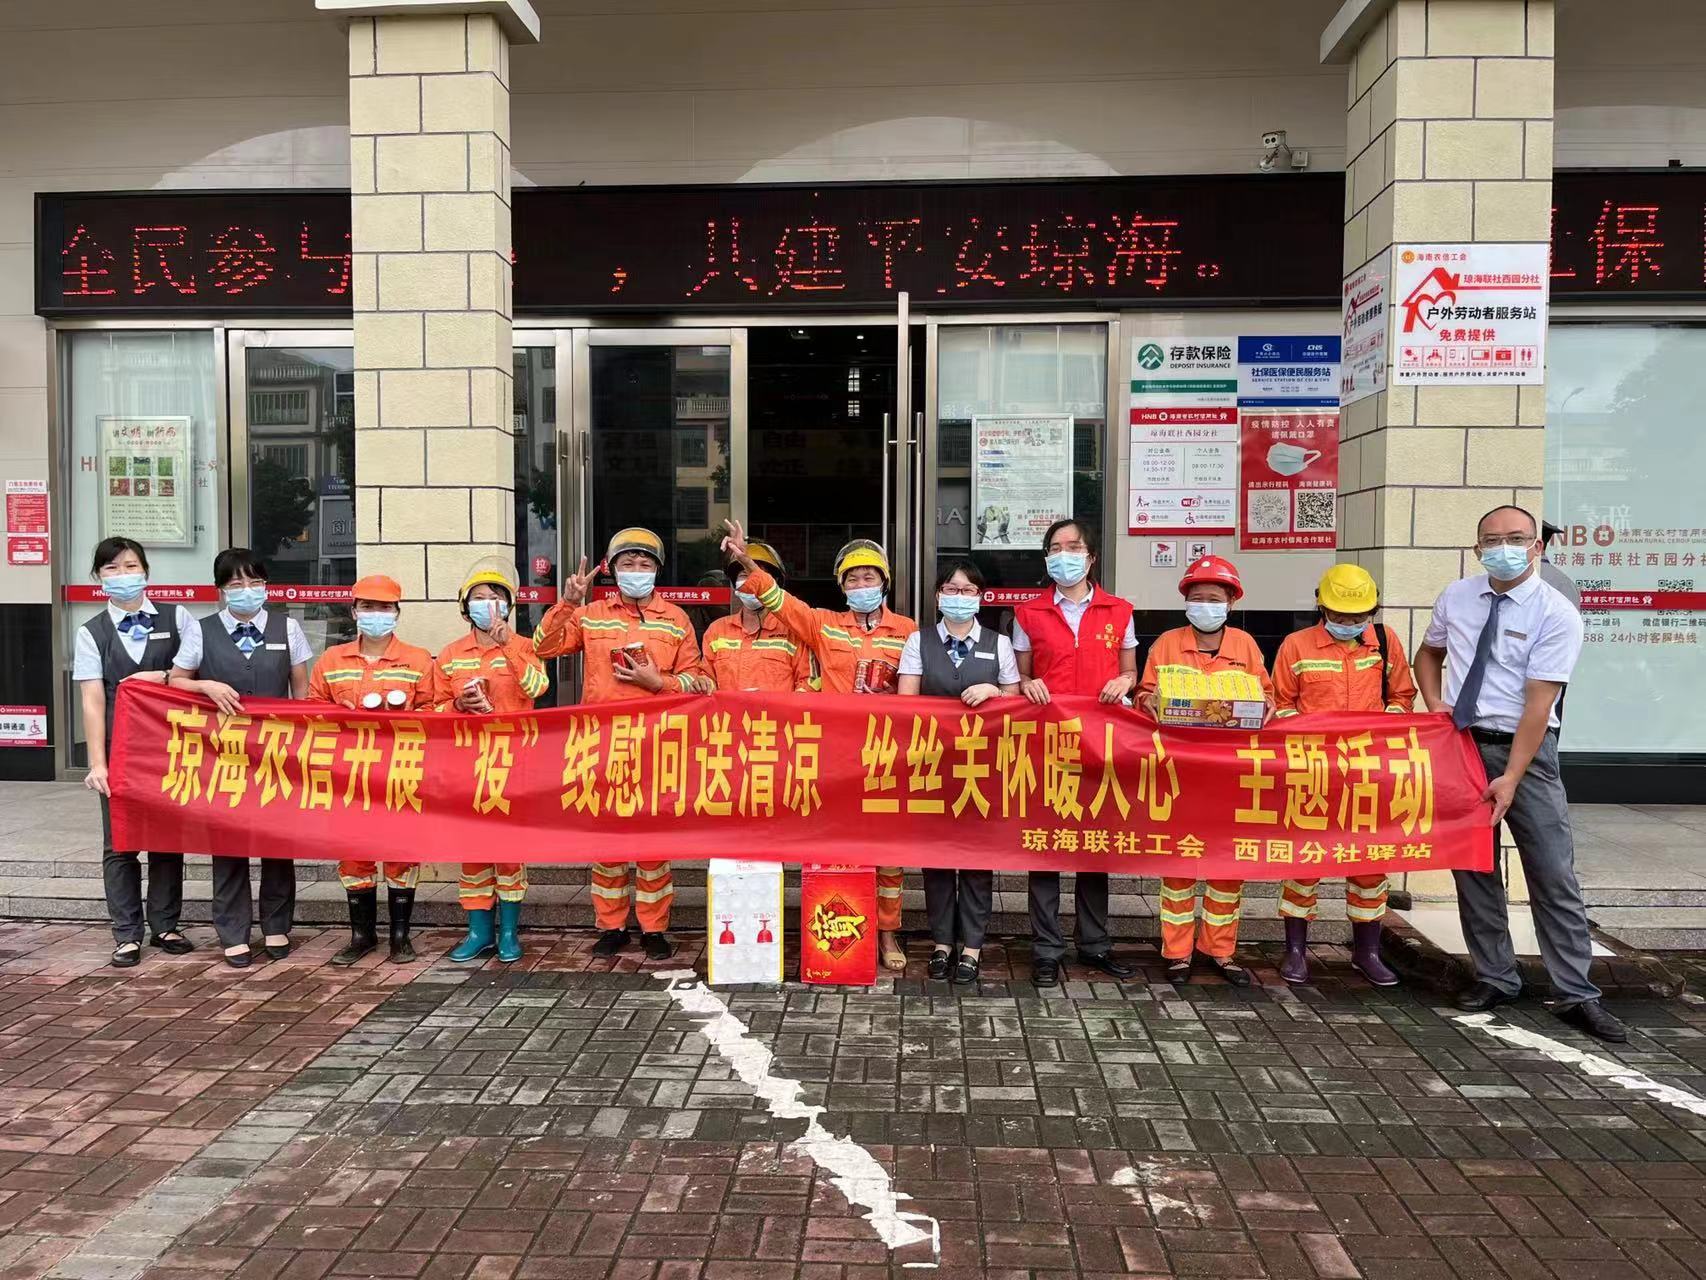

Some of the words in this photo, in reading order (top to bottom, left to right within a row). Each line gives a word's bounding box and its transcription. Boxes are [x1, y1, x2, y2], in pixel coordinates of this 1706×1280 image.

[1416, 252, 1467, 261] 海南农信工会
[1463, 274, 1540, 284] 琼海联社西园分社
[1426, 306, 1537, 320] 户外劳动者服务站
[1439, 328, 1496, 342] 免费提供
[1170, 346, 1231, 361] 存款保险
[1251, 367, 1331, 377] 社保医保便民服务站
[1251, 420, 1290, 429] 疫情防控
[1296, 419, 1335, 428] 人人有责
[1272, 431, 1315, 439] 请佩戴口罩
[535, 558, 547, 569] 拉
[1642, 617, 1706, 627] 微信银行二维码
[1610, 632, 1697, 643] 24小时客服热线
[861, 709, 1181, 821] 丝丝关怀暖人心
[1234, 727, 1434, 836] 主题活动
[1022, 828, 1206, 858] 琼海联社工会
[1232, 838, 1434, 863] 西园分社驿站
